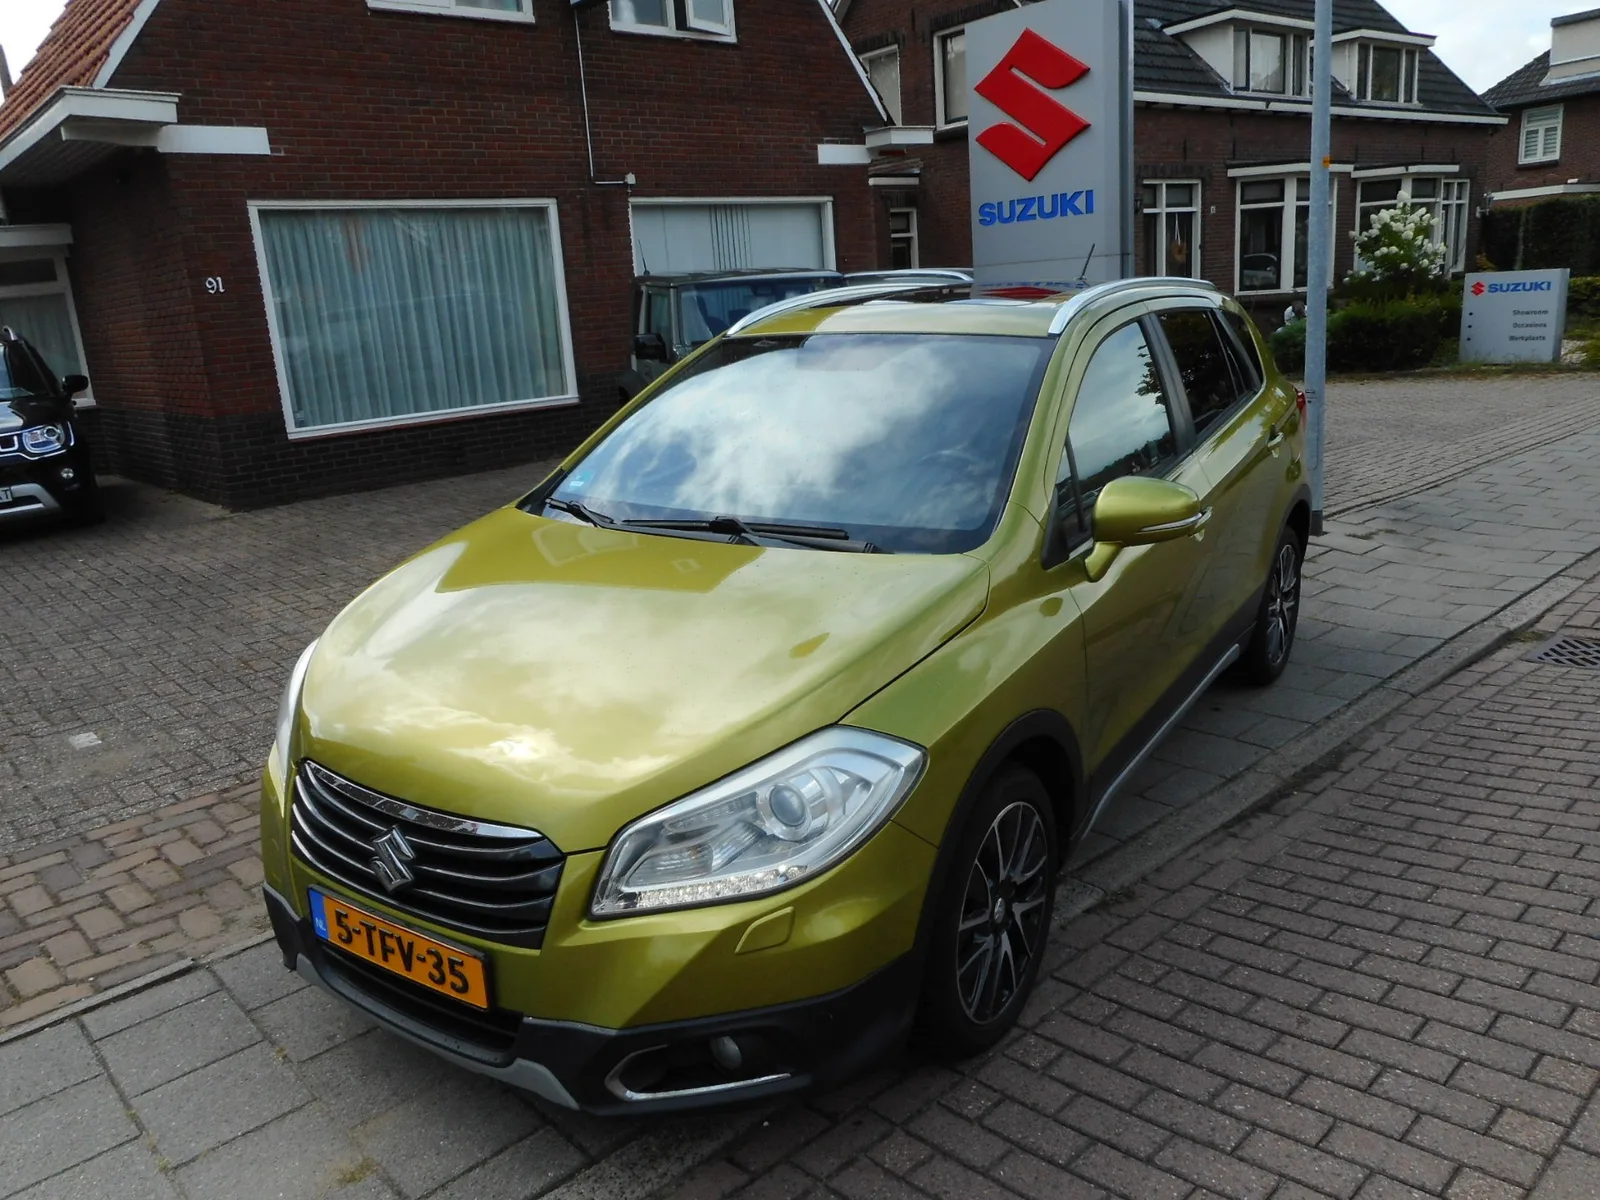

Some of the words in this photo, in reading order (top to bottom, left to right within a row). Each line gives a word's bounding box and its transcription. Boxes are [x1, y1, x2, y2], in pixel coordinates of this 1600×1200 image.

[978, 189, 1094, 227] SUZUKI
[205, 276, 226, 294] 91
[1487, 281, 1552, 294] SUZUKI
[315, 917, 326, 931] NL
[335, 909, 469, 994] 5-TFV-35
